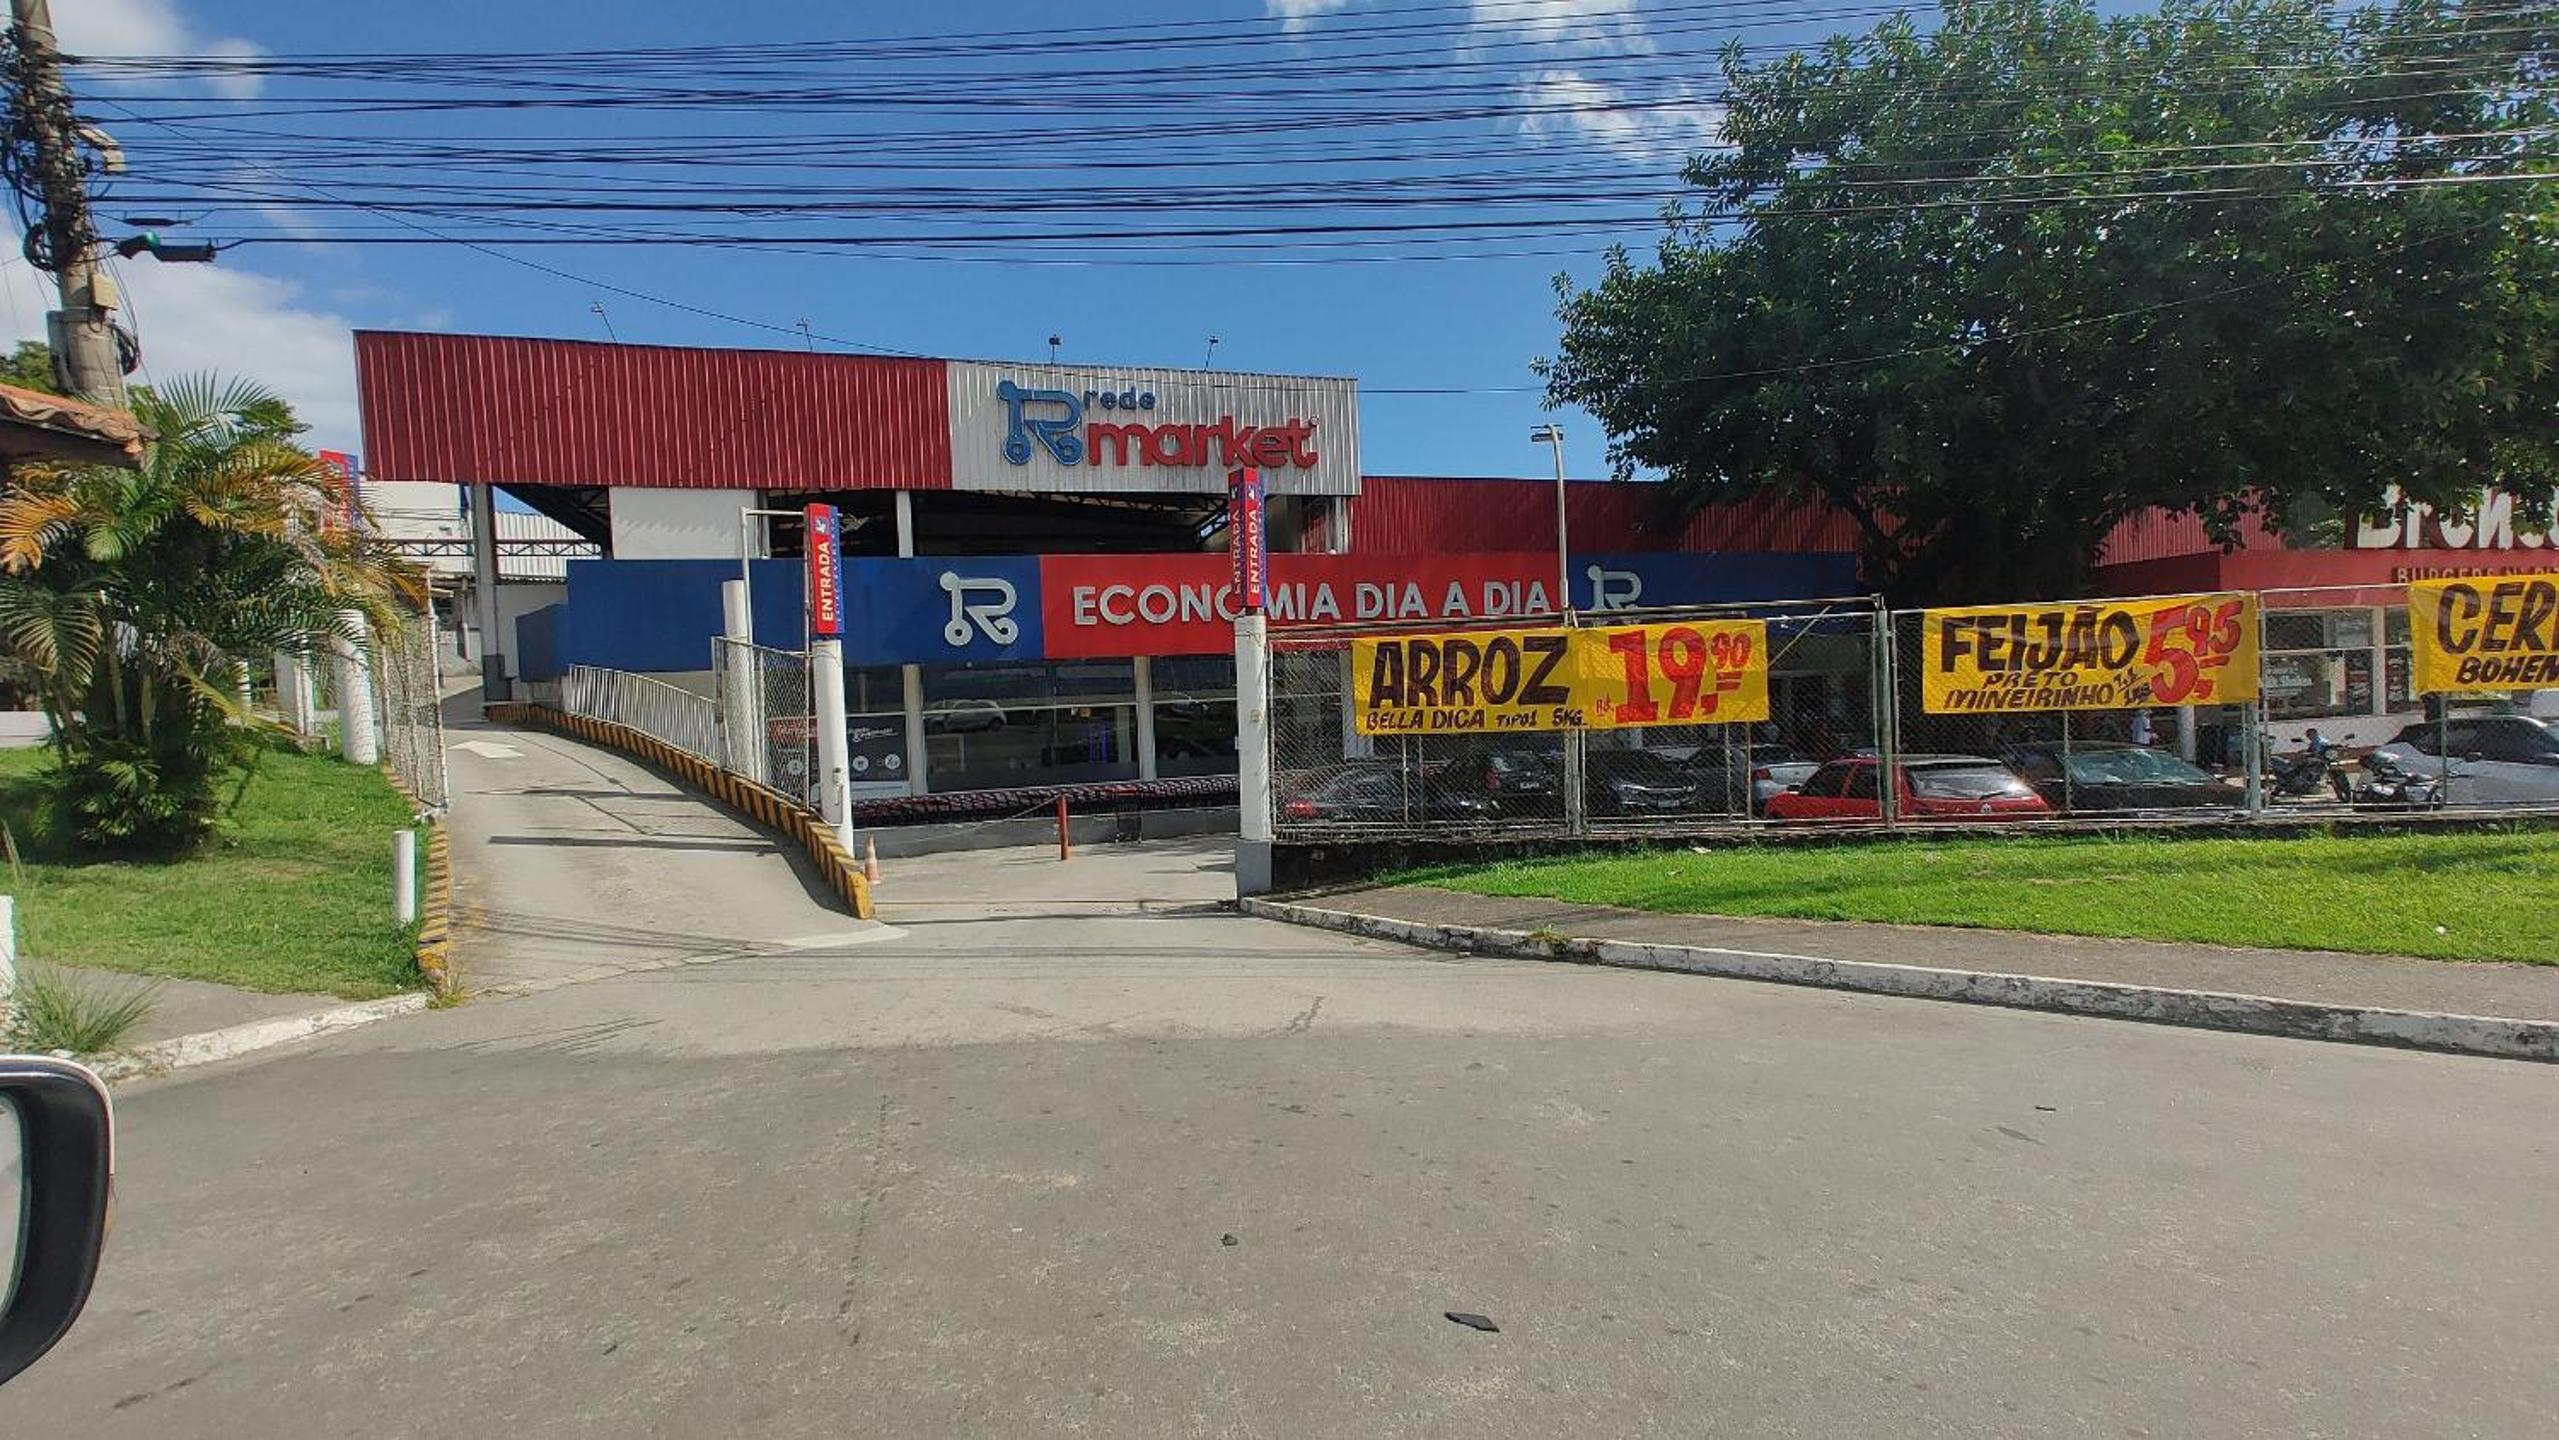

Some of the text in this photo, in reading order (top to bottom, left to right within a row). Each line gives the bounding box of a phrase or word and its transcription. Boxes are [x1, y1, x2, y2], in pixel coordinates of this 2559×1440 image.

[1083, 386, 1156, 411] rede
[1087, 415, 1318, 467] market
[1249, 509, 1259, 594] ENTRADA
[818, 541, 834, 621] ENTRADA
[1355, 582, 1428, 618] DIA
[1442, 581, 1471, 617] A
[1483, 580, 1552, 615] DIA
[1941, 606, 2140, 672] FEIJÃO
[2438, 581, 2559, 654] CER
[1369, 636, 1570, 708] ARROZ
[1944, 683, 2115, 709] MINEIRINHO
[1982, 671, 2078, 688] PRETO
[1366, 709, 1424, 730] BELLA
[1431, 708, 1485, 729] DICA
